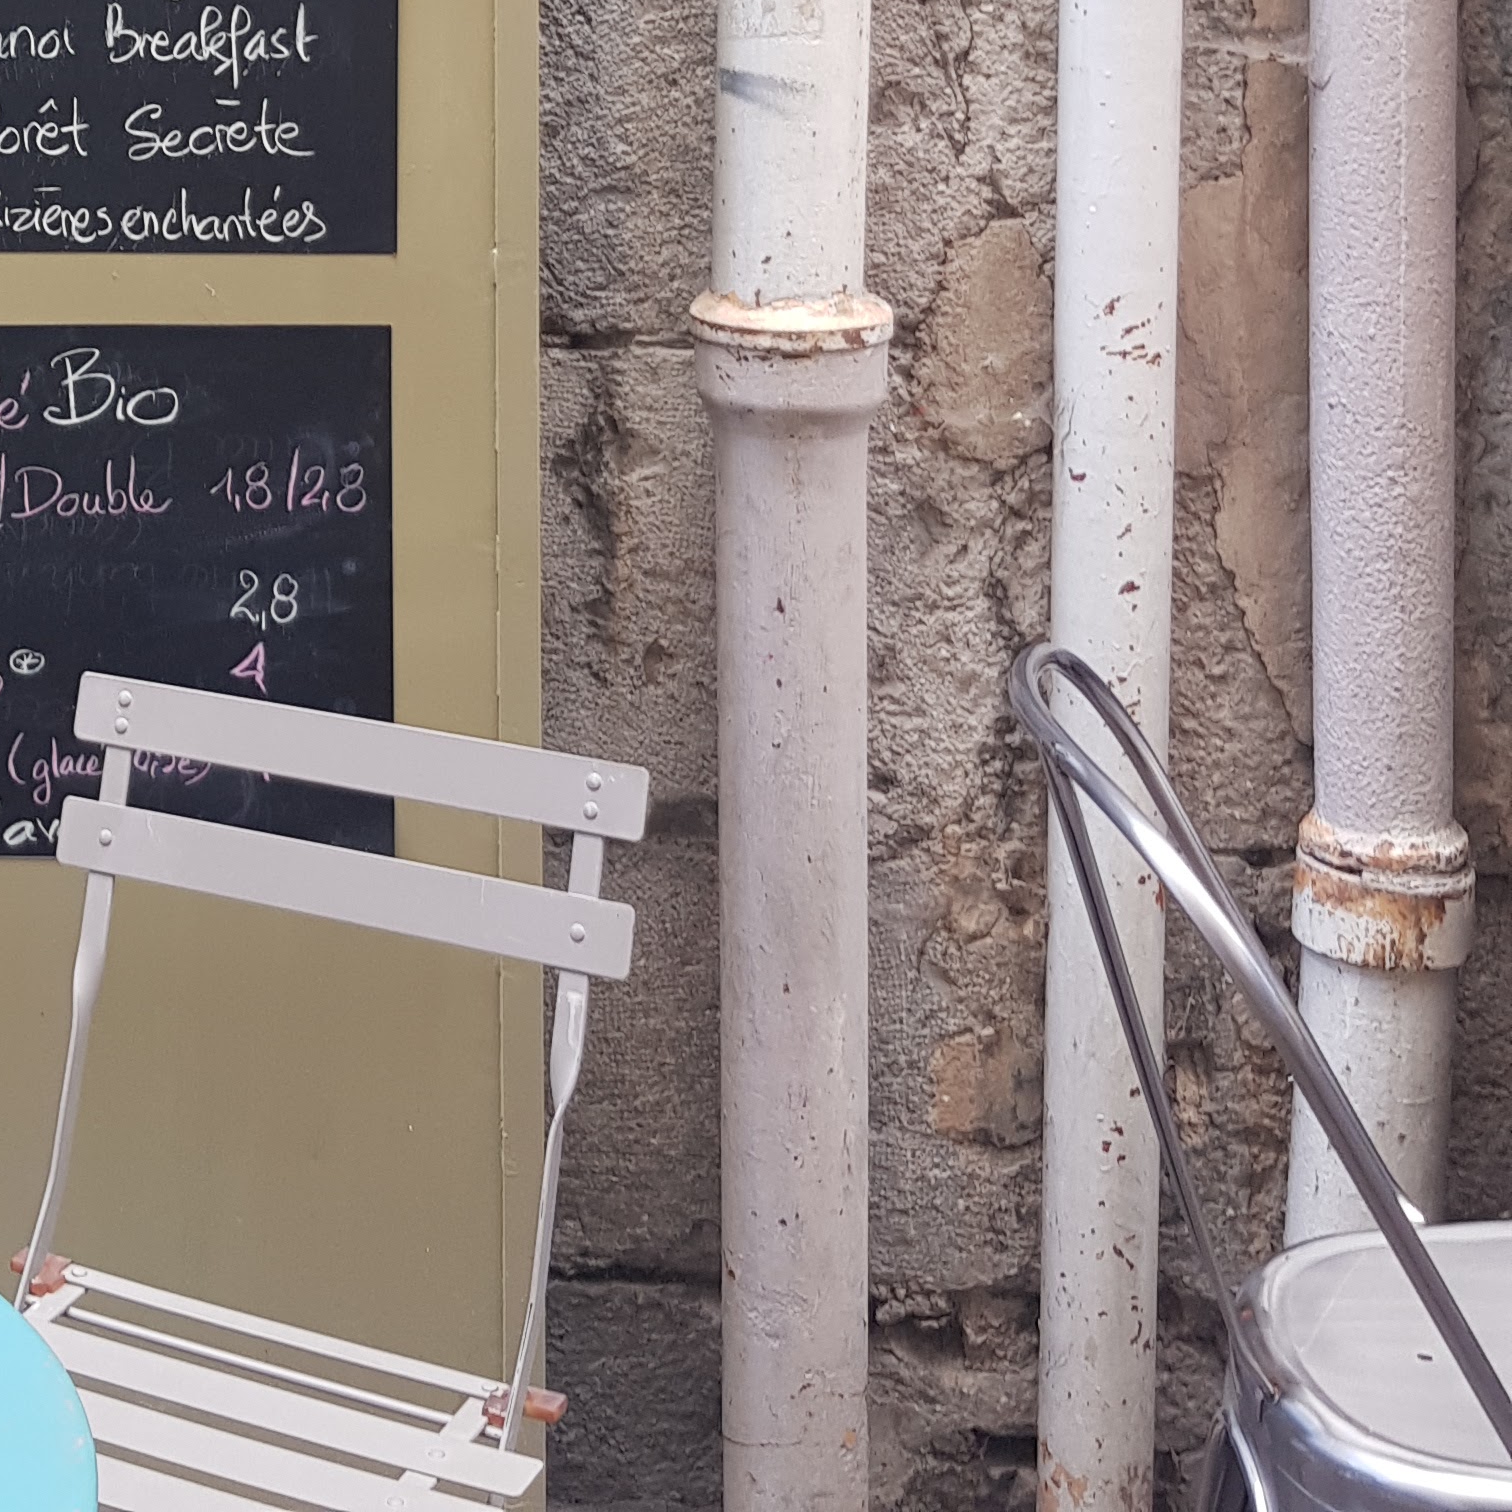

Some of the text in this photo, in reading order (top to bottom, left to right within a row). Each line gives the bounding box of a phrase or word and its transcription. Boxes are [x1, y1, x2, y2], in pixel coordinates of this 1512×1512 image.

[106, 2, 319, 88] Breakfast
[43, 346, 179, 425] Bio
[229, 568, 299, 630] 2,8
